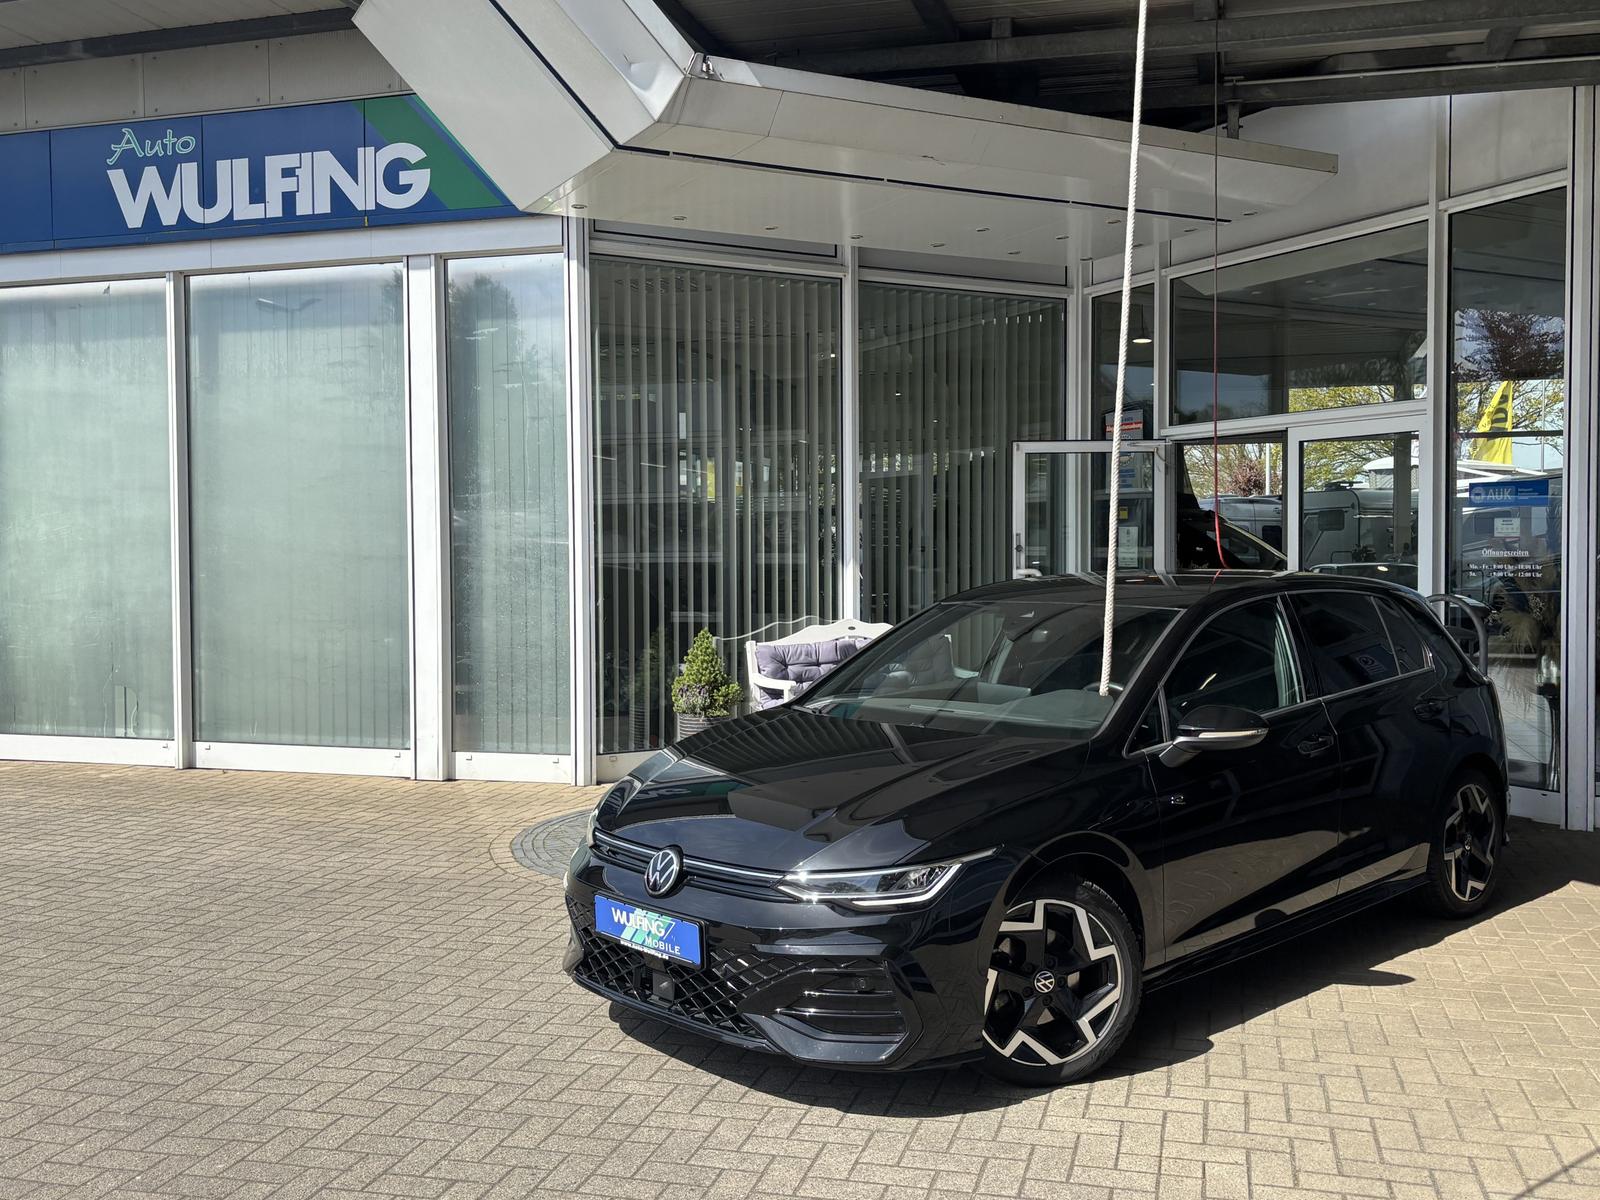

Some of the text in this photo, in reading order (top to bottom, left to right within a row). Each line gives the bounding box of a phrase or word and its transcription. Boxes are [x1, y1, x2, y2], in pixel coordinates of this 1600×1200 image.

[106, 128, 196, 165] Auto
[106, 142, 431, 229] WULFING
[1486, 487, 1512, 501] AUK
[1481, 548, 1529, 557] Öffnungszeiten
[611, 907, 665, 936] WULFING
[645, 937, 681, 954] MOBILE
